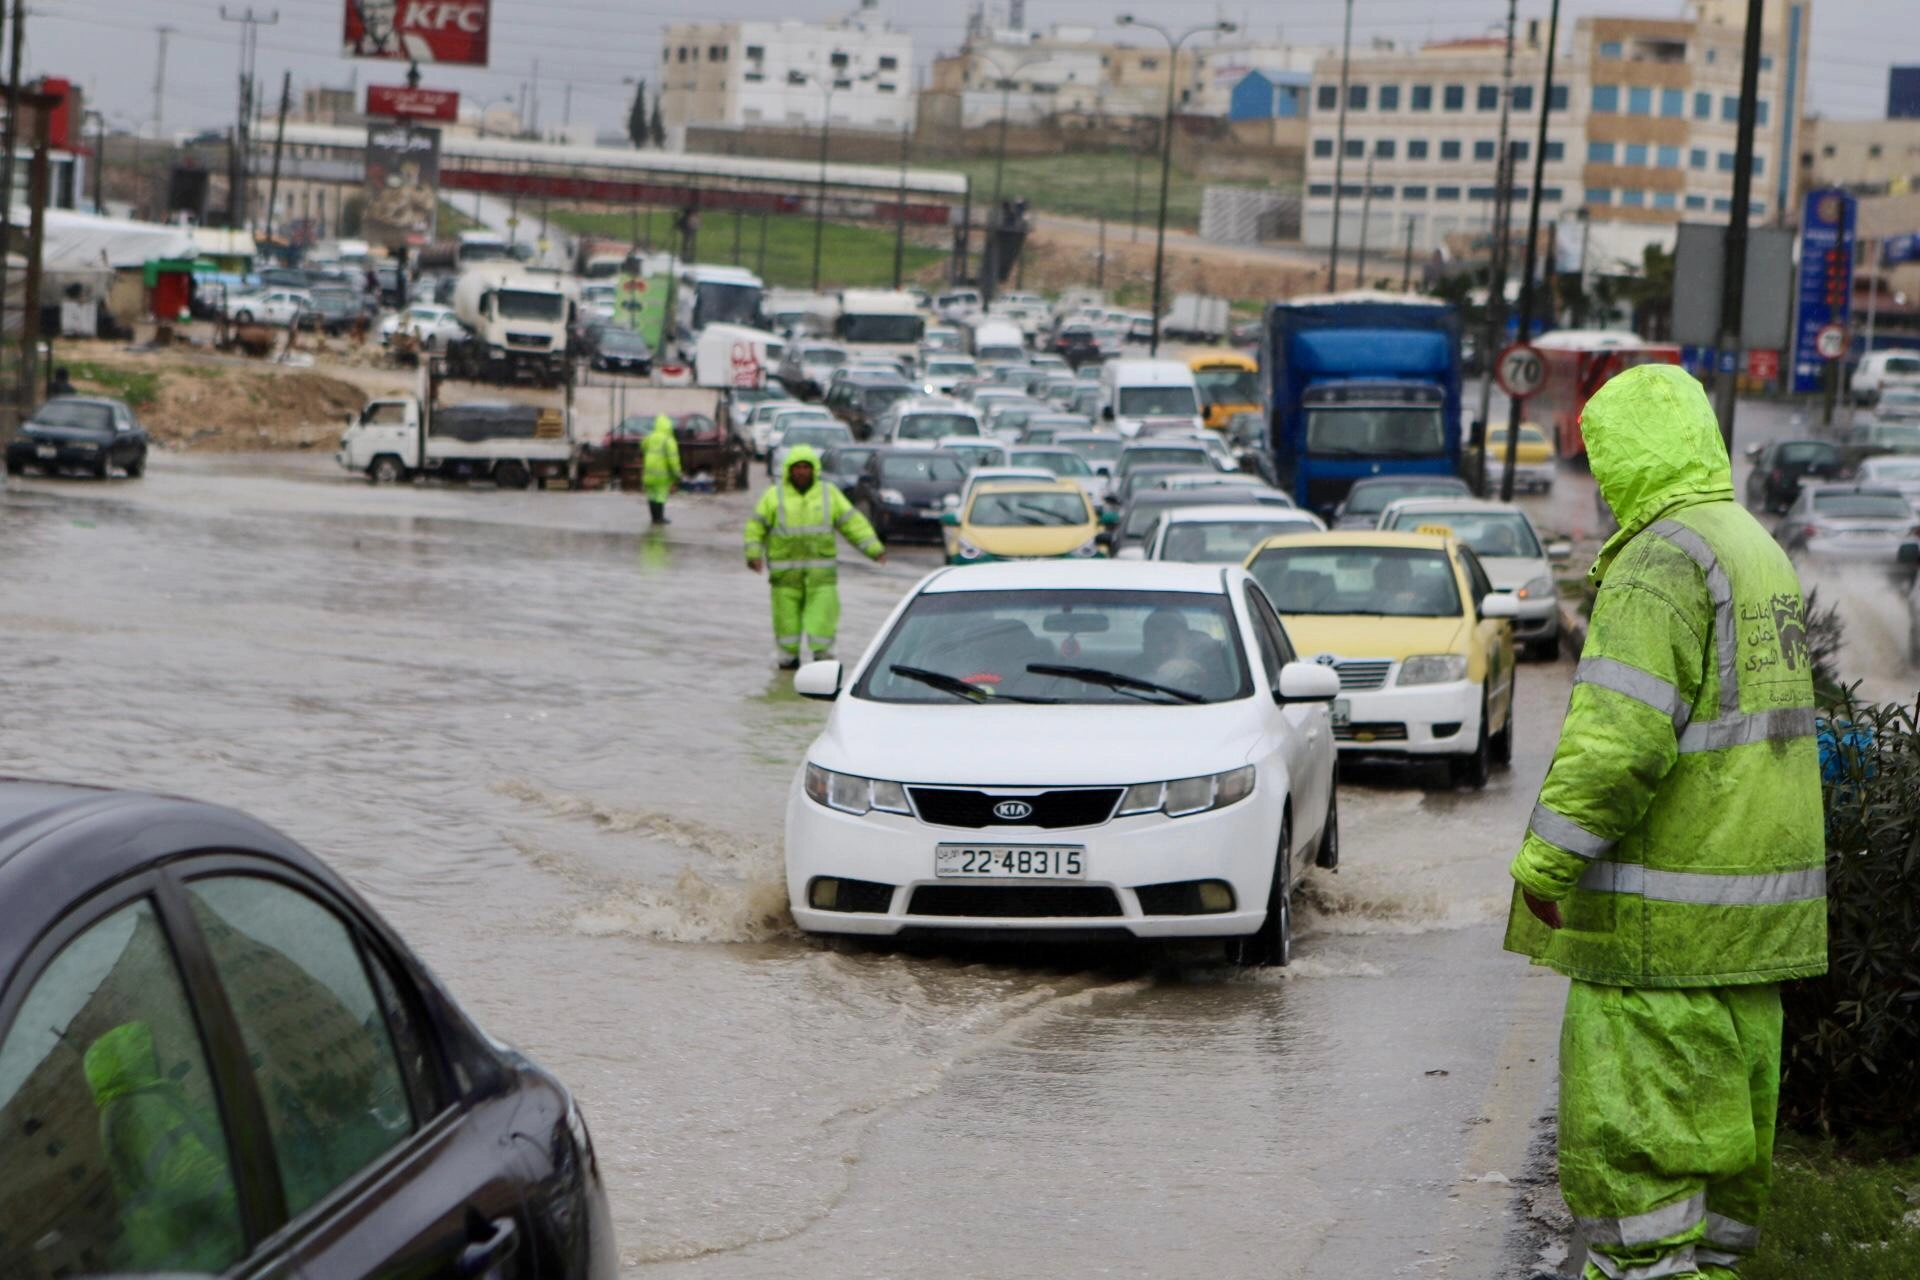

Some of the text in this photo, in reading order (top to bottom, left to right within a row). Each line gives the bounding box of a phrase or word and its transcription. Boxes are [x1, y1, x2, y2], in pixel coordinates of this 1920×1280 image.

[403, 2, 484, 32] KFC
[1509, 356, 1541, 384] 70
[1000, 805, 1026, 815] KIA
